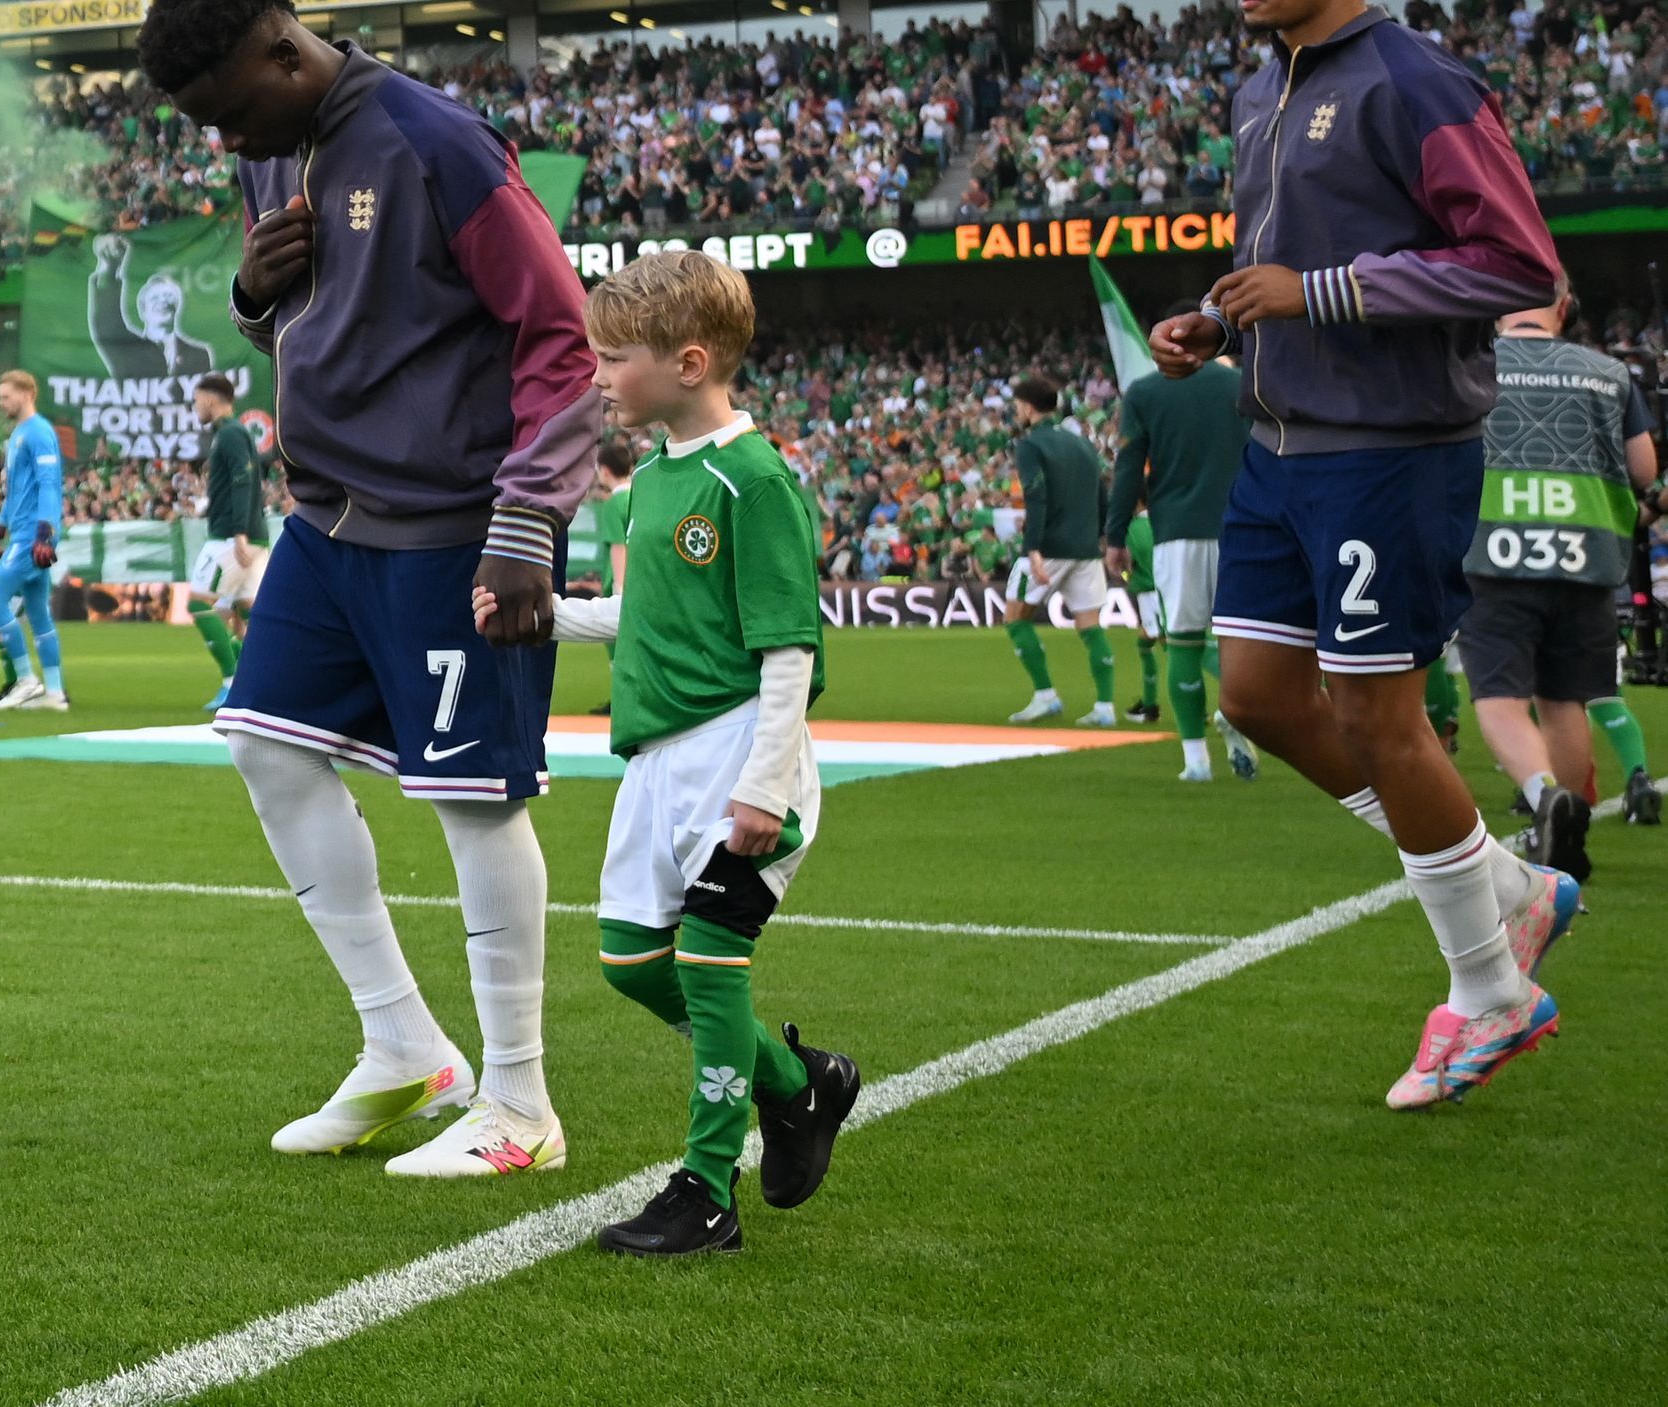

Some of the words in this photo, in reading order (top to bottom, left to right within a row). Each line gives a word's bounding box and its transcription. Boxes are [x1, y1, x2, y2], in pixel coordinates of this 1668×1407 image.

[702, 231, 814, 271] SEPT
[955, 213, 1235, 261] FAI.IE/TICK
[48, 376, 175, 405] THANK
[176, 368, 251, 403] YU
[1562, 374, 1620, 397] LEAGUE
[81, 405, 153, 433] FOR
[156, 404, 212, 431] TH
[1501, 476, 1577, 517] HB
[1486, 527, 1589, 574] 033
[1337, 539, 1380, 615] 2
[426, 649, 466, 733] 7
